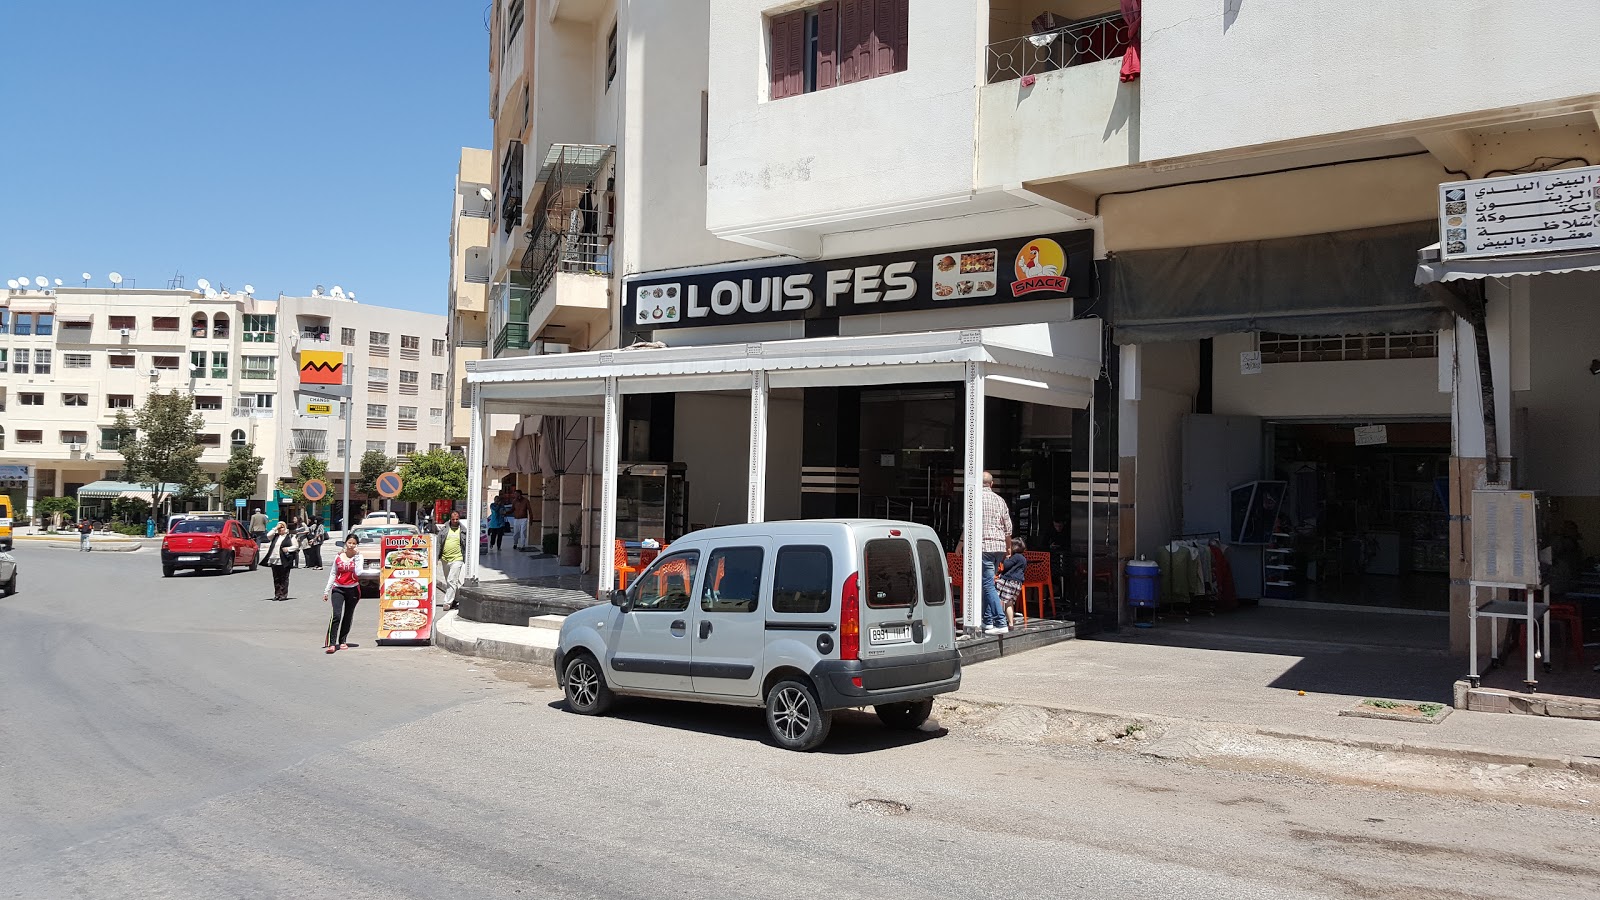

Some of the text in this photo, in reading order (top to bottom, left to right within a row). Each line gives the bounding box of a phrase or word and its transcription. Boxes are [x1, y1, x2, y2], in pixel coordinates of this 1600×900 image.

[1474, 175, 1592, 199] البيض البلدي
[1476, 237, 1526, 250] بالبيض
[687, 261, 917, 318] LOUIS FES
[1015, 278, 1064, 293] SNACK
[385, 538, 410, 546] Louis
